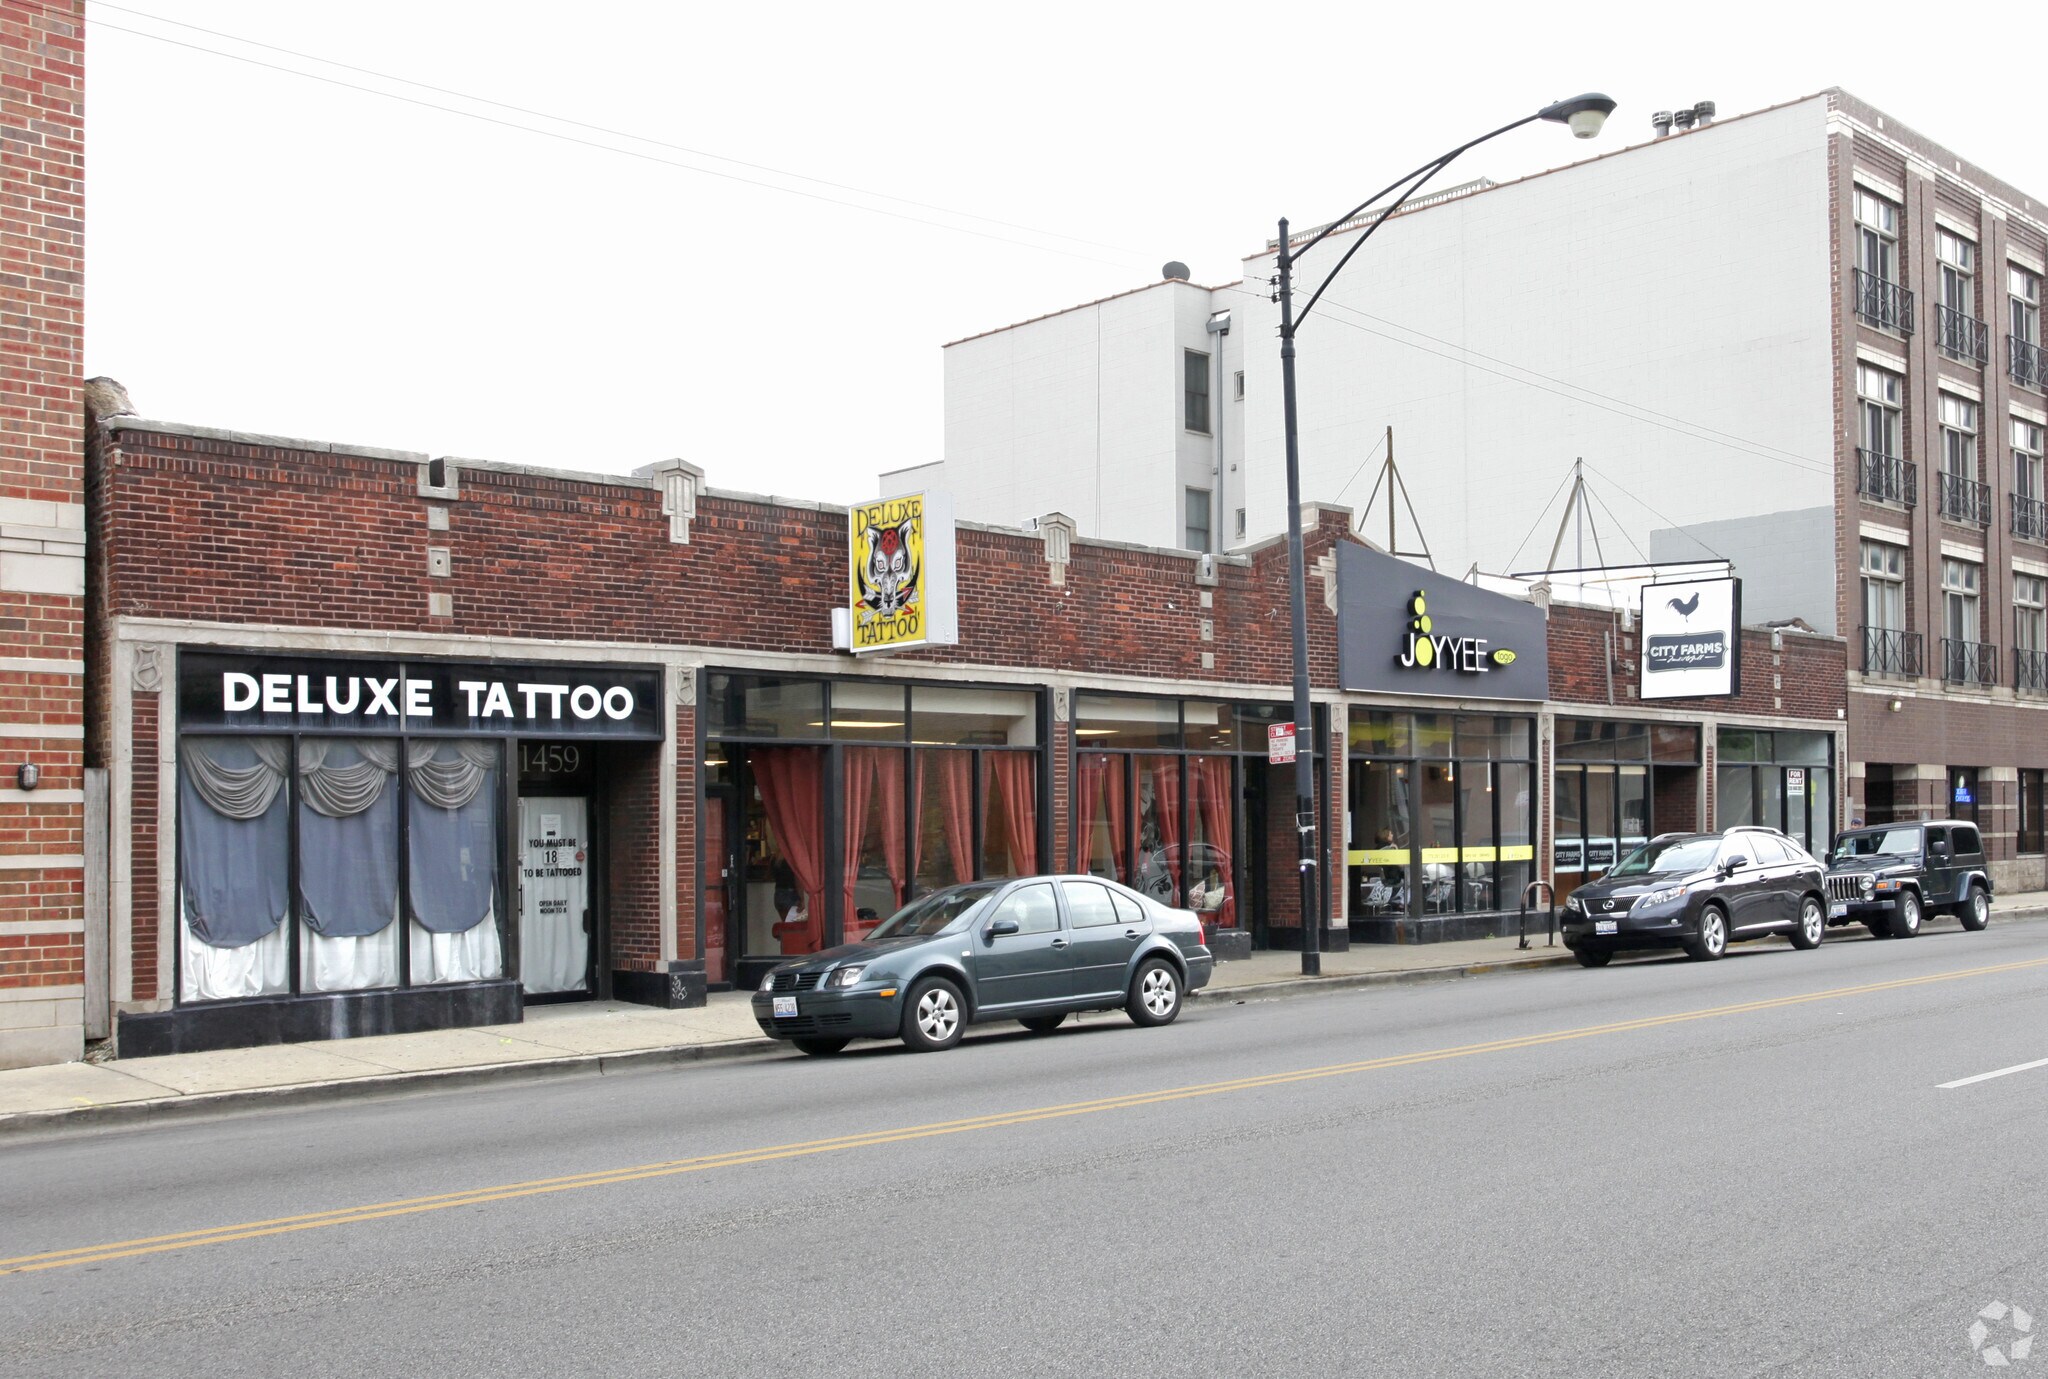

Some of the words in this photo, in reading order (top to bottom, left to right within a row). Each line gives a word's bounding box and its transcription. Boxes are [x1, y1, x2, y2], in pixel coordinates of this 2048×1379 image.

[856, 500, 921, 538] DELUXE
[857, 615, 918, 645] TATTOO
[1650, 645, 1679, 657] CITY
[1680, 642, 1723, 656] FARMS
[223, 672, 433, 716] DELUXE
[458, 681, 634, 721] TATTOO
[520, 744, 580, 773] 1459
[529, 839, 544, 848] YOU
[546, 839, 566, 848] MUST
[568, 838, 577, 847] BE
[545, 850, 558, 863] 18
[524, 869, 534, 878] TO
[536, 868, 544, 877] BE
[546, 867, 582, 877] TATTOOED
